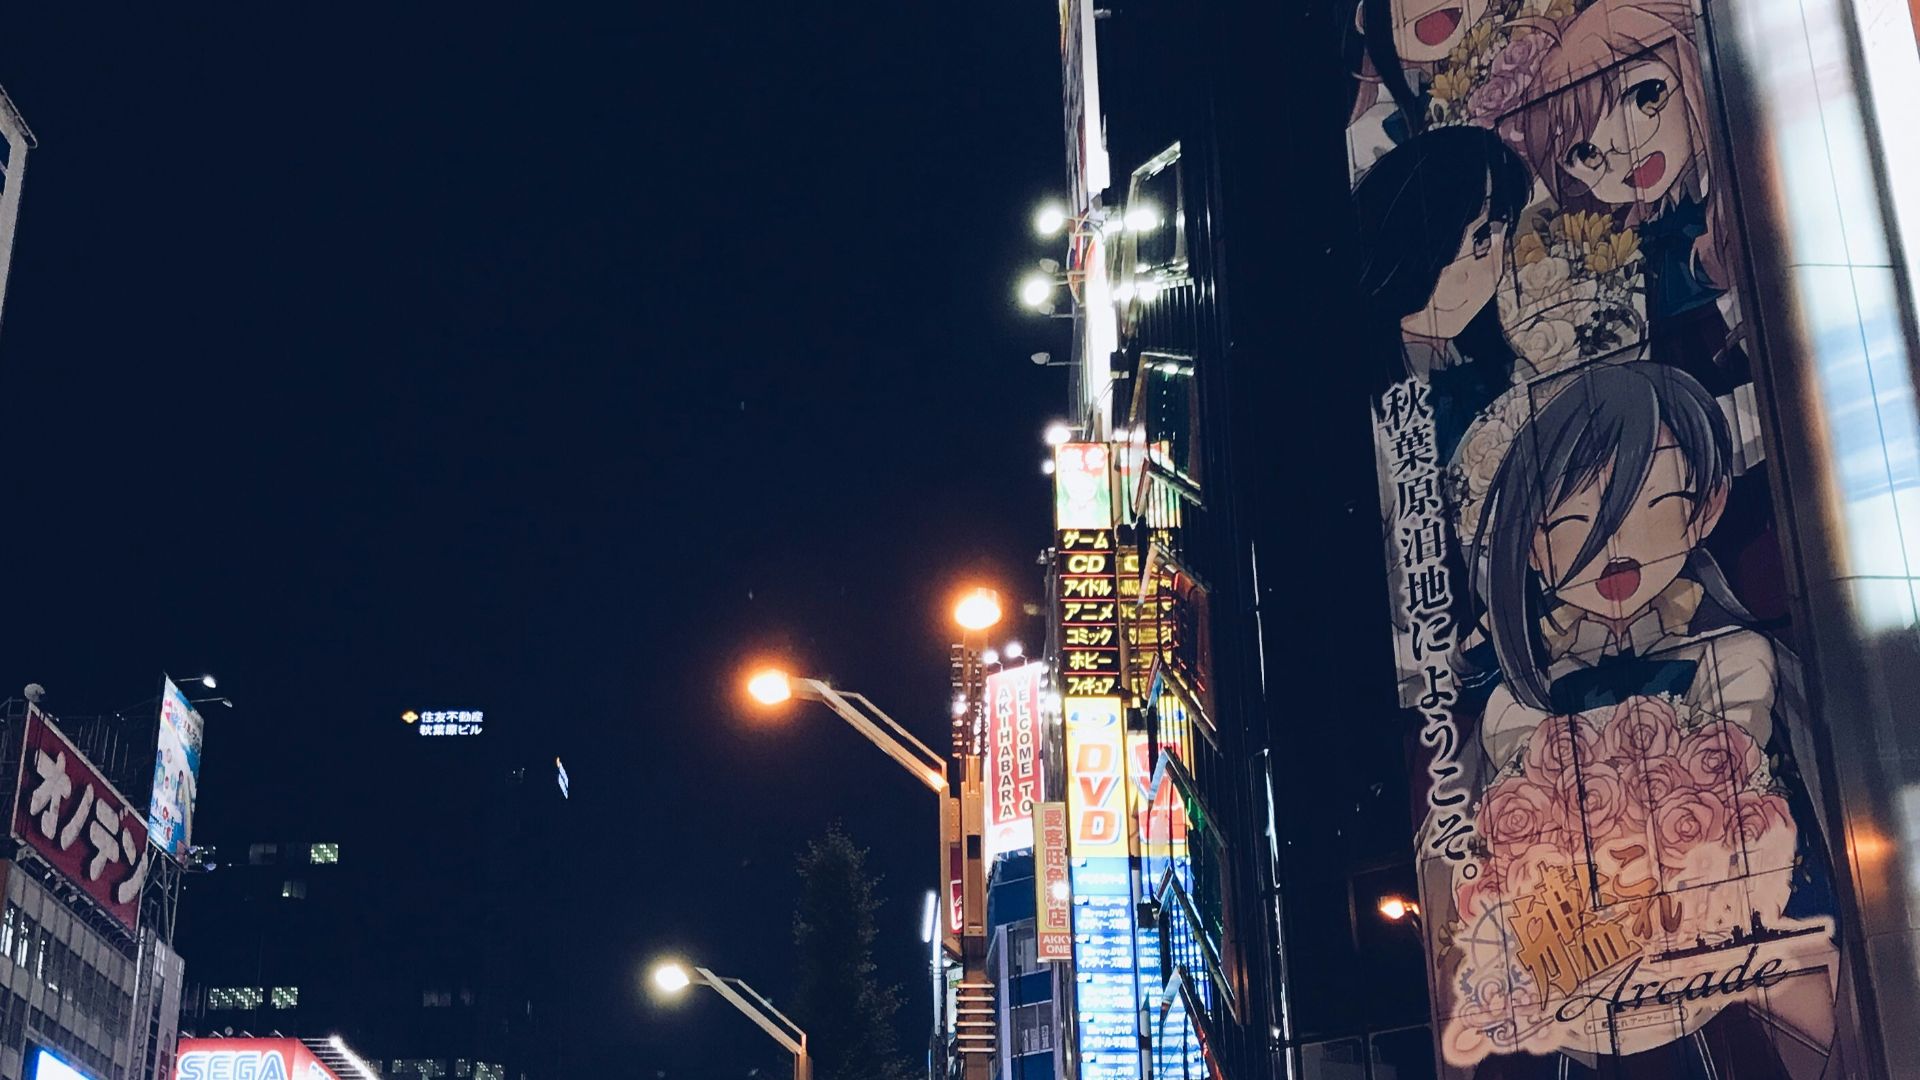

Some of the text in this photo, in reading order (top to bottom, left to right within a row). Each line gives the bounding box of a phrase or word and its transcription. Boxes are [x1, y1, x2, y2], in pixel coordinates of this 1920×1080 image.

[1063, 531, 1109, 549] ゲーム
[1068, 554, 1106, 573] CD
[1064, 579, 1112, 597] アイドル
[1064, 603, 1114, 621] アニメ
[1066, 628, 1113, 646] コミック
[1386, 380, 1477, 880] 秋葉原泊地にようこそ。
[1070, 652, 1112, 670] ホビー
[1067, 677, 1115, 695] フィギュア
[420, 711, 484, 723] 住友不動産
[419, 724, 483, 736] 秋葉原ビル
[999, 689, 1014, 818] AKIHABARA
[1021, 784, 1034, 813] TO
[1076, 744, 1119, 841] DVD
[30, 749, 149, 904] オノデン
[1046, 945, 1071, 954] ONE
[1556, 945, 1795, 1022] Arcade
